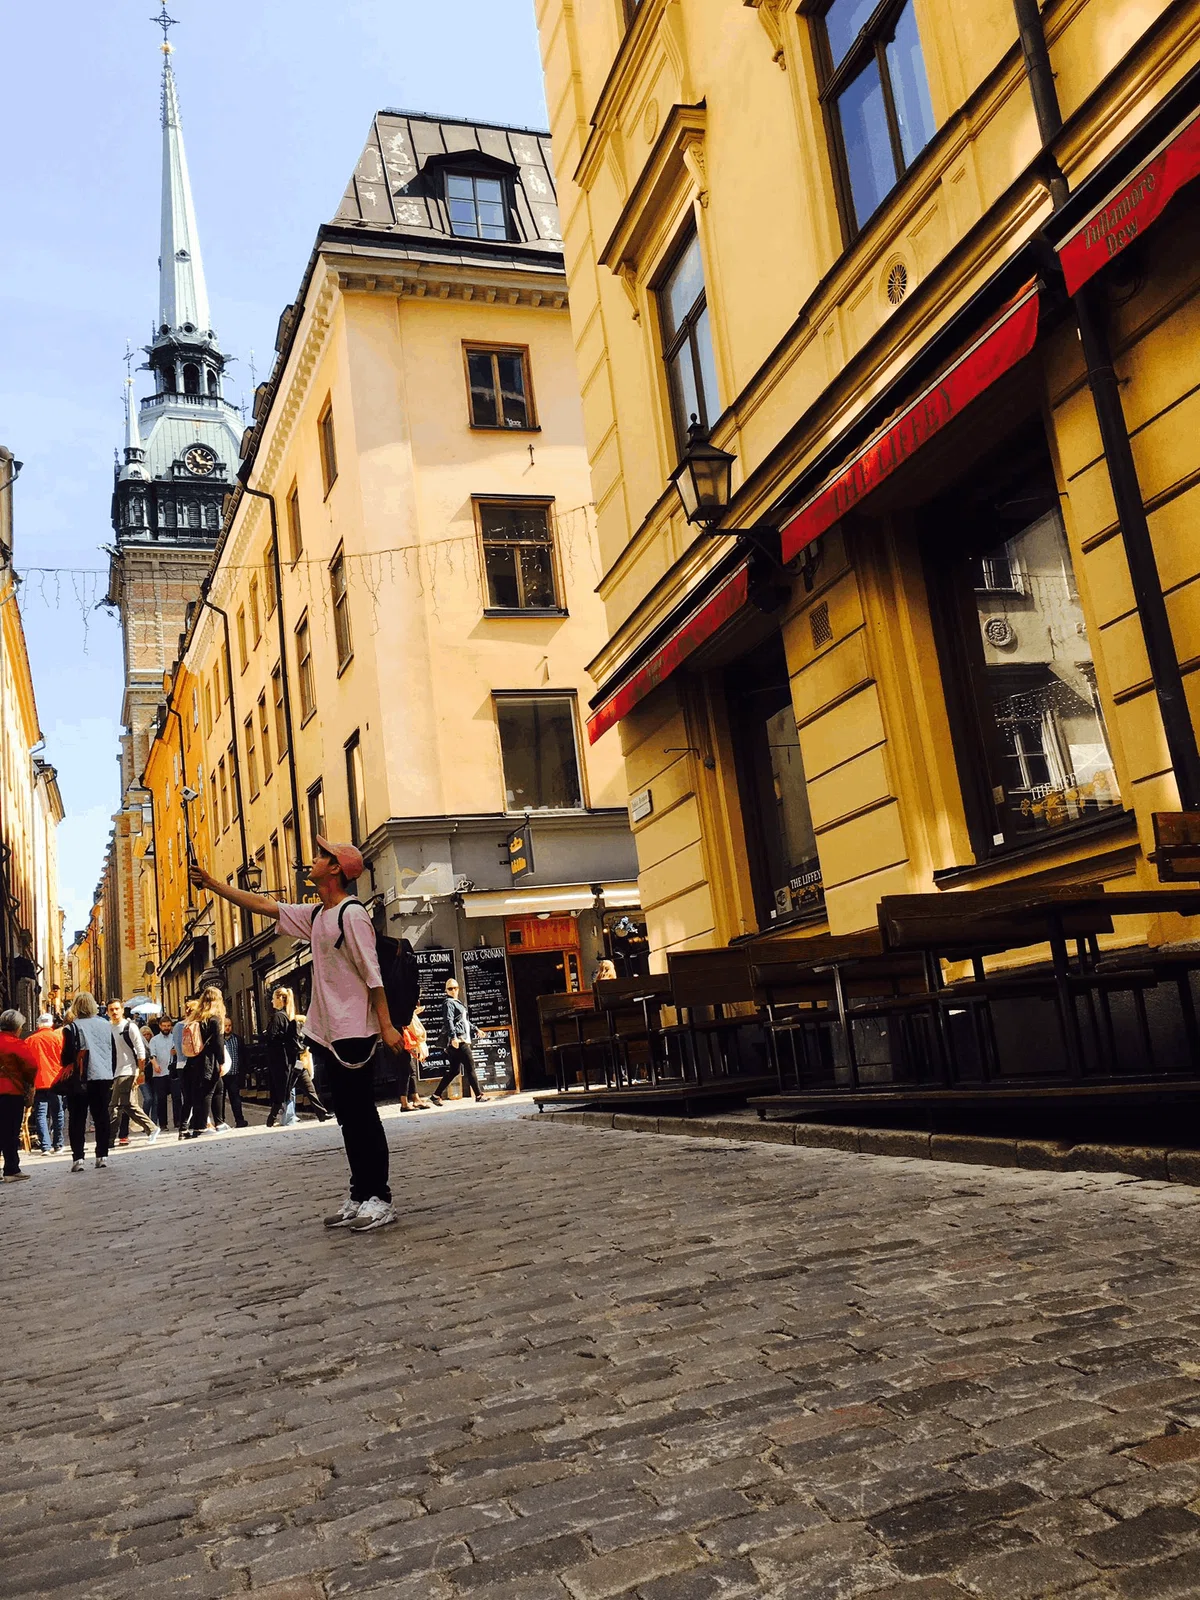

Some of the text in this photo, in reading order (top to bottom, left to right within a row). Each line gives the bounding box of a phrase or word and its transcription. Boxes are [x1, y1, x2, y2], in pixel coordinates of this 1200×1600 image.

[1082, 173, 1155, 250] Tullamore
[1105, 215, 1139, 258] Dew
[790, 869, 822, 890] THE LIFFEY
[416, 953, 428, 964] AFE
